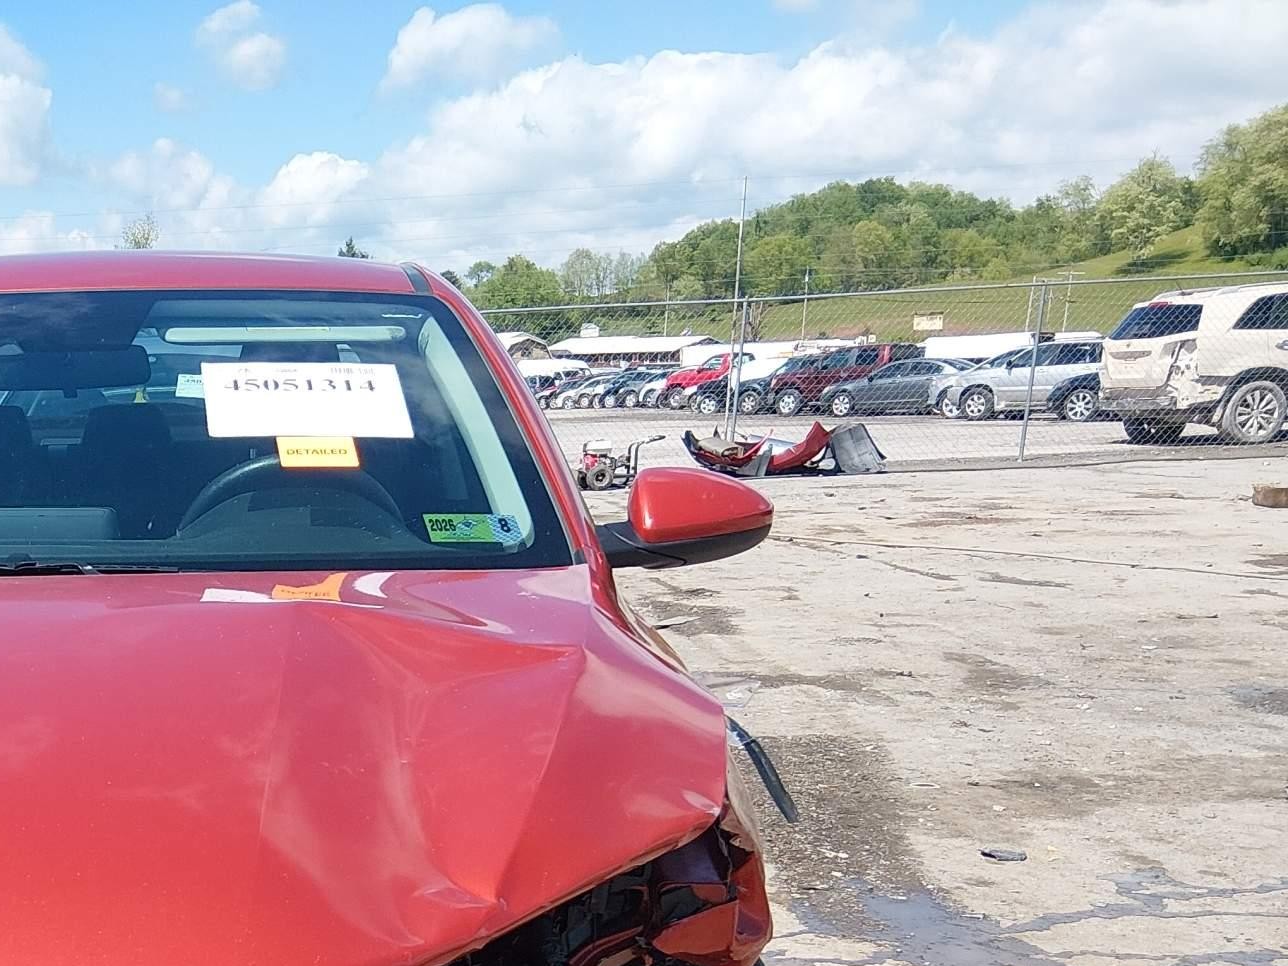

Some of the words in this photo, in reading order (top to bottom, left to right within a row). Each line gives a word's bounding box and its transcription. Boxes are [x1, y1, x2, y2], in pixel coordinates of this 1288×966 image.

[224, 379, 375, 391] 45051314
[428, 518, 456, 532] 2026
[498, 517, 511, 533] 8
